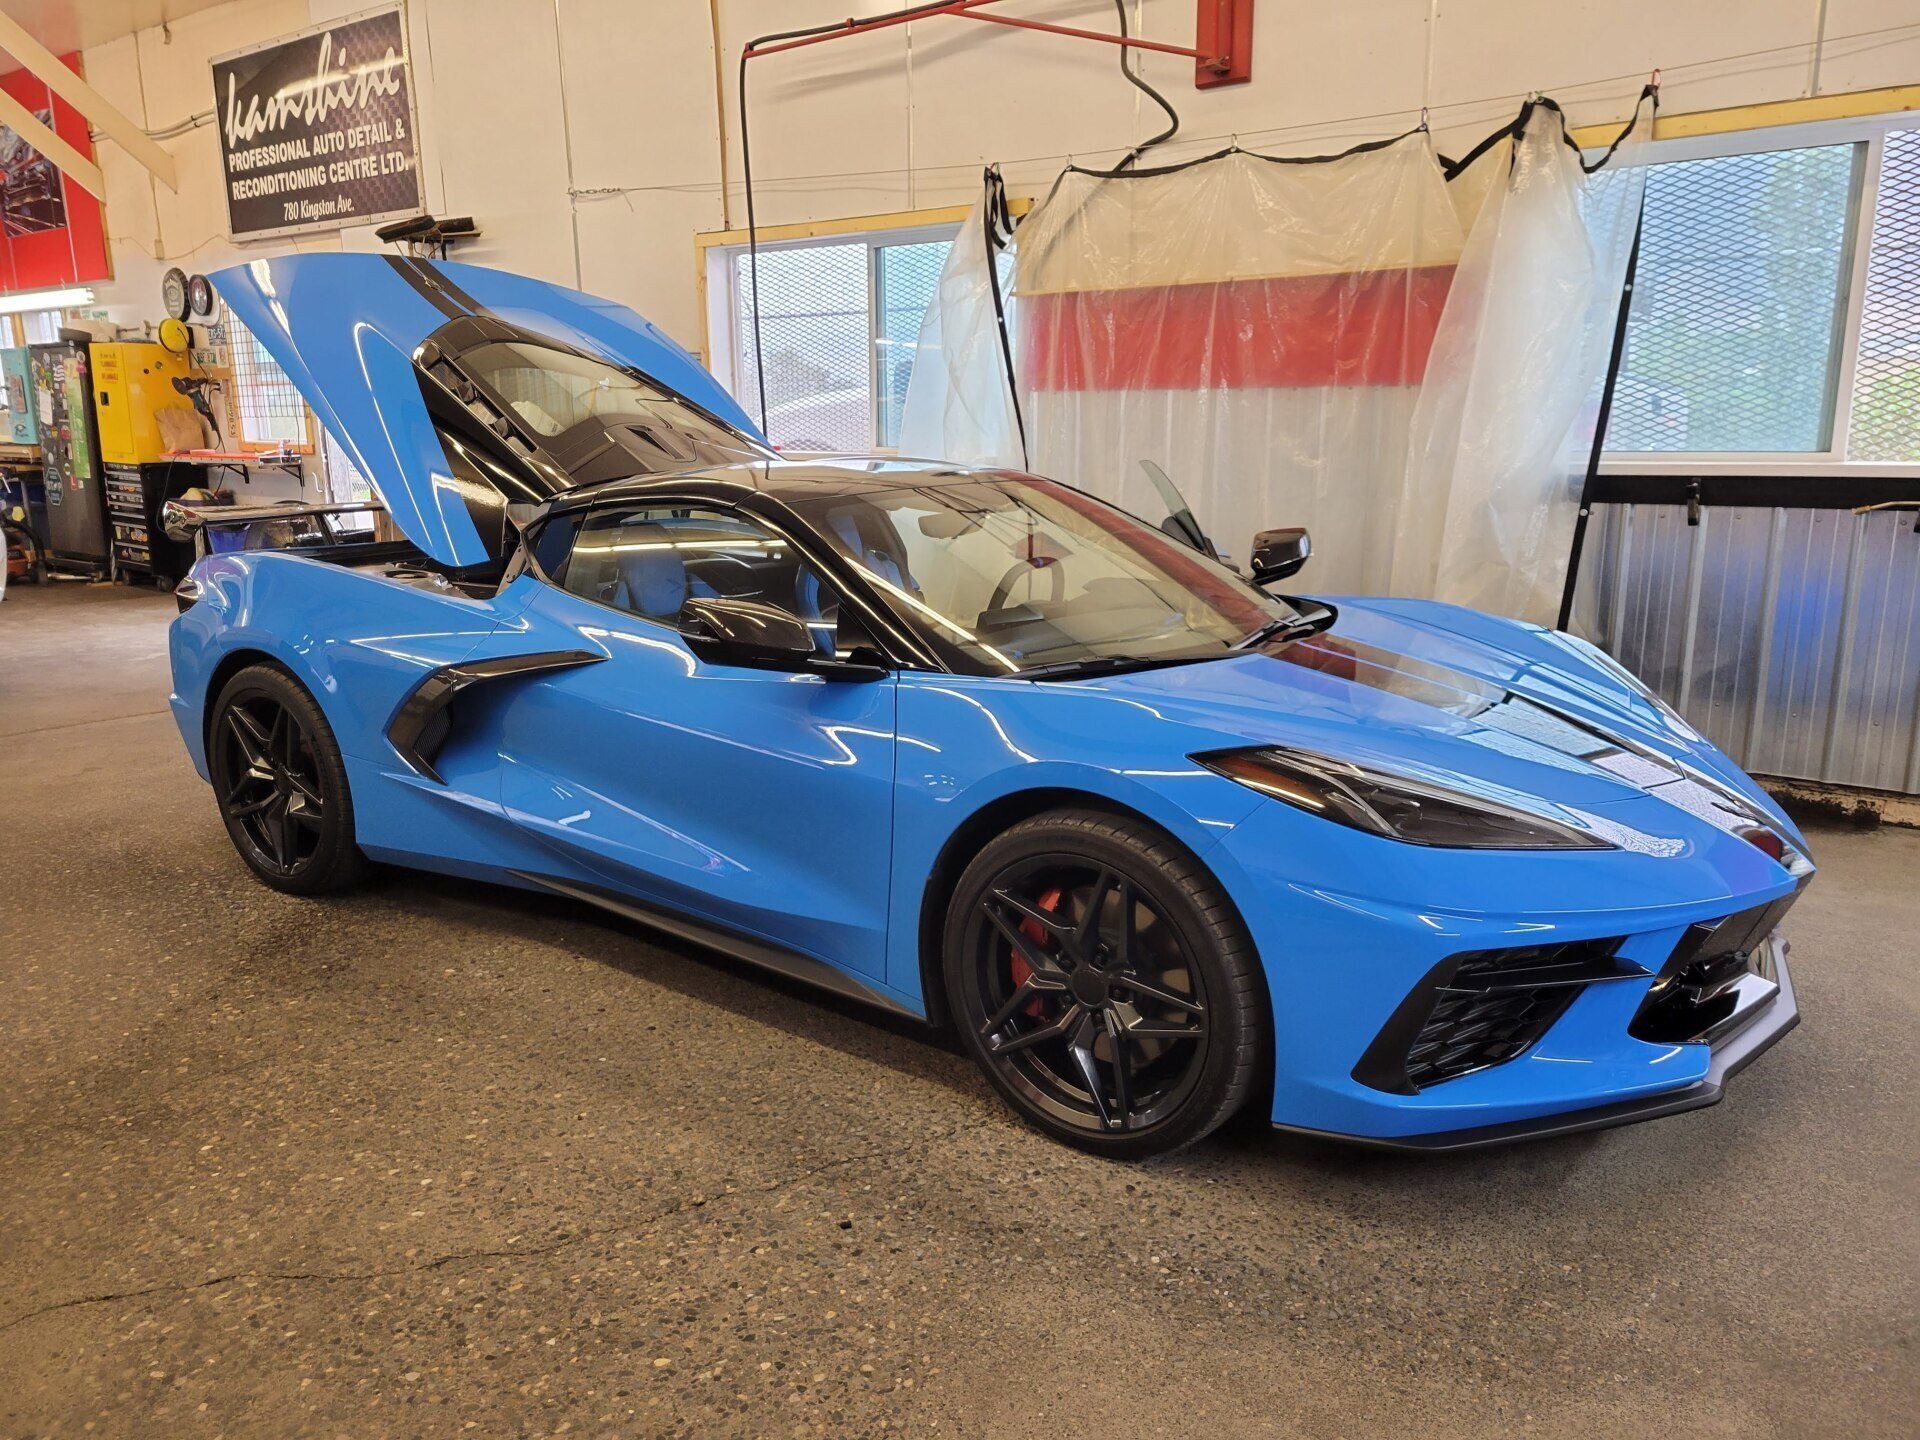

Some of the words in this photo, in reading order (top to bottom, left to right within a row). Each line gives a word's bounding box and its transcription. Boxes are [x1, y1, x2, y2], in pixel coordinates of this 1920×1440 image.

[229, 138, 310, 173] PROFESSIONAL
[313, 130, 345, 156] AUTO
[348, 121, 392, 149] DETAIL
[396, 118, 405, 140] &
[232, 167, 326, 200] RECONDITIONING
[329, 157, 378, 183] CENTRE
[381, 151, 409, 175] LTD.
[284, 202, 299, 221] 780
[300, 199, 336, 220] Kingston
[337, 194, 355, 214] Ave.
